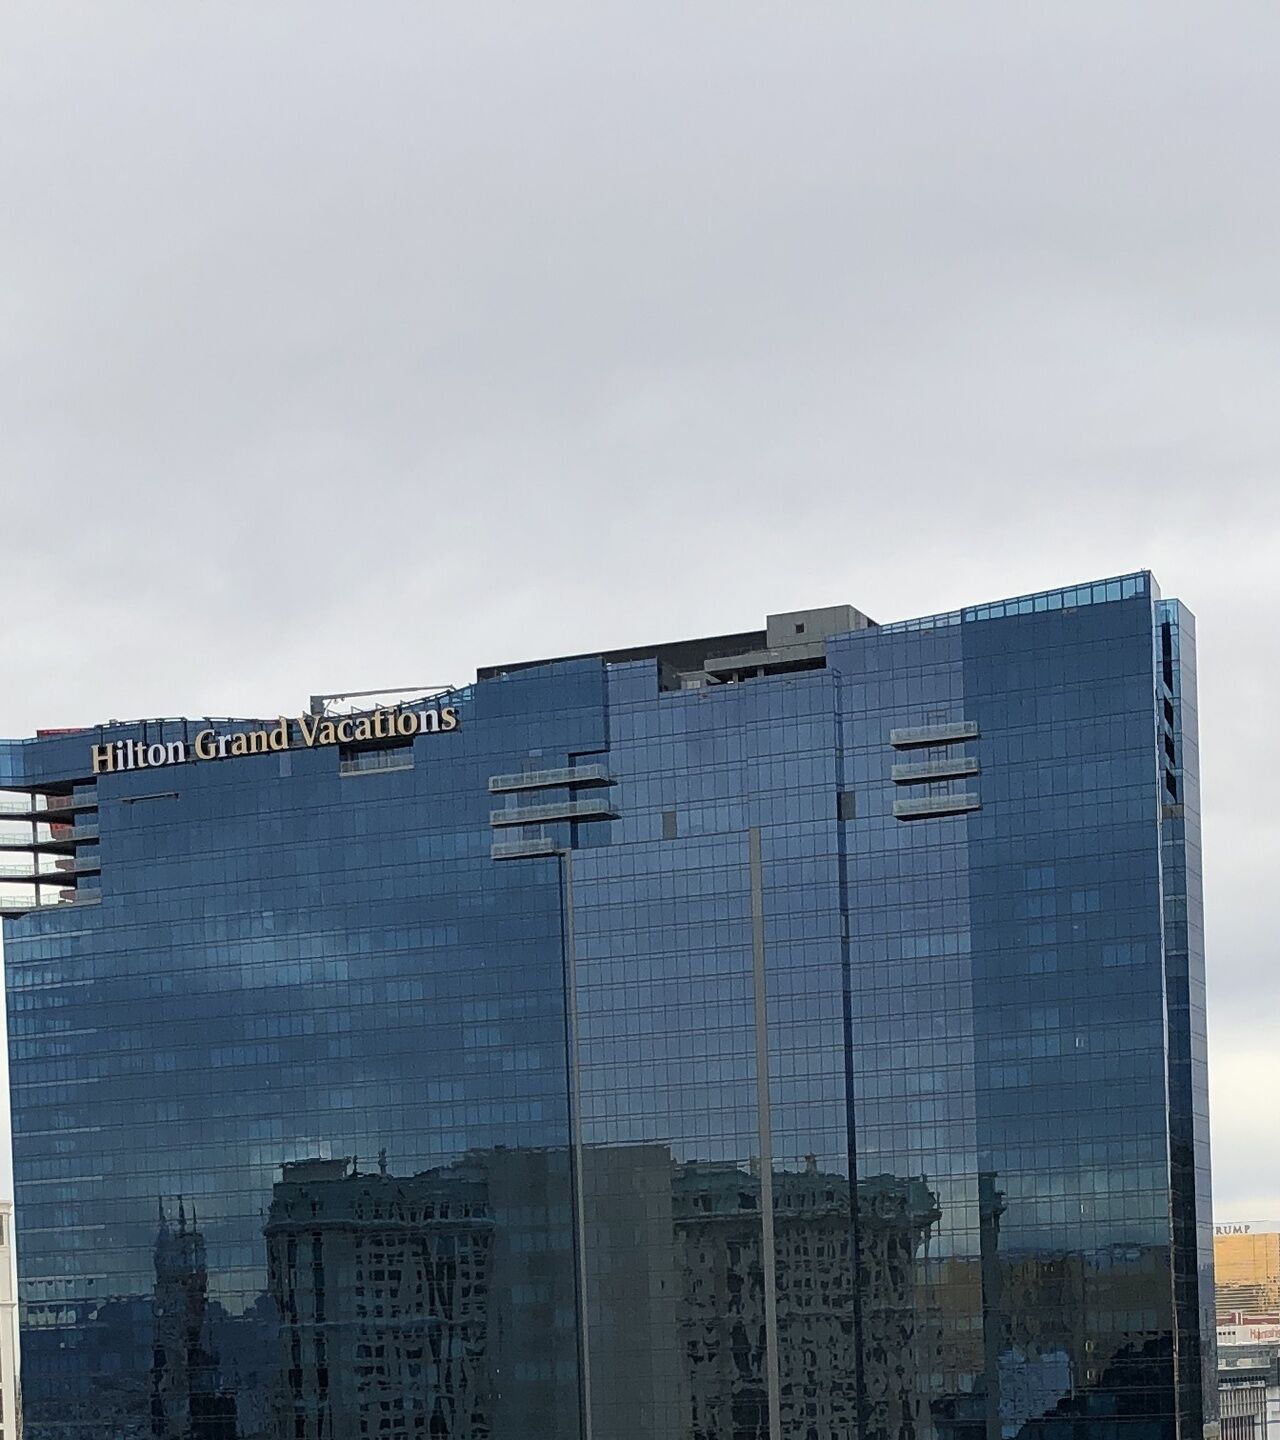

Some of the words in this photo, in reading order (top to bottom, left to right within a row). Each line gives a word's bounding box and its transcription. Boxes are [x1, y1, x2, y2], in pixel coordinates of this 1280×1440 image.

[91, 738, 185, 774] Hilton
[194, 717, 289, 760] Grand
[297, 706, 458, 746] Vacations
[1215, 1224, 1251, 1235] RUMP
